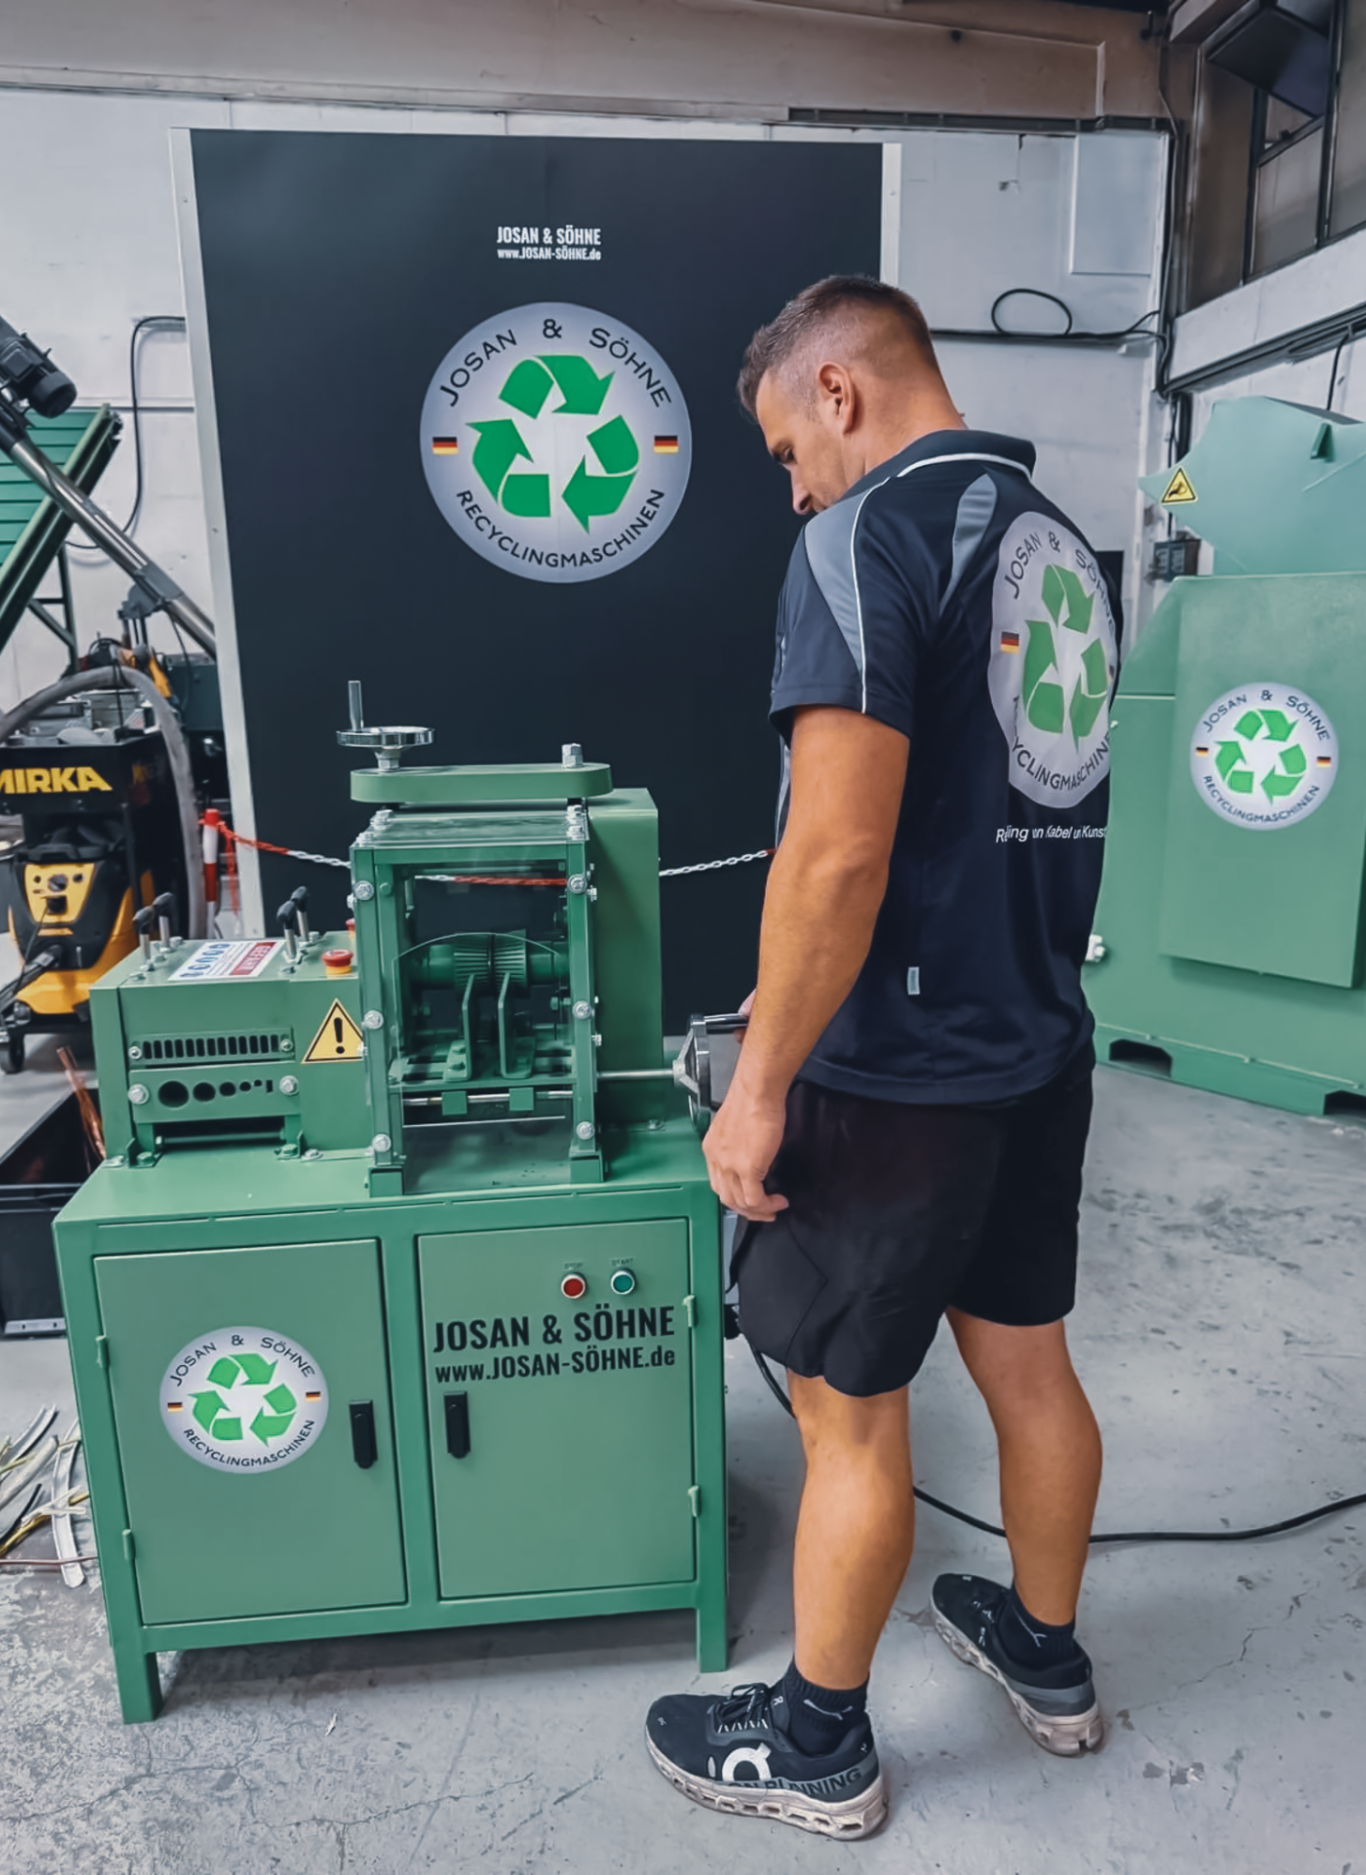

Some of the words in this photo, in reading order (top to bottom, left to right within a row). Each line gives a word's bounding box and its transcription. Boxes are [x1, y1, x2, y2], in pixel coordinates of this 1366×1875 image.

[497, 226, 539, 243] JOSAN
[543, 227, 553, 244] &
[556, 224, 602, 245] SÖHNE
[497, 245, 602, 260] www.JOSAN-SÖHNE.de
[440, 329, 518, 407] JOSAN
[542, 318, 562, 339] &
[589, 327, 672, 408] SÖHNE
[456, 489, 665, 568] RECYCLINGMASCHINEN
[1004, 532, 1043, 600] JOSAN
[1048, 530, 1061, 553] &
[1203, 694, 1247, 733] JOSAN
[1261, 690, 1273, 701] &
[1286, 695, 1331, 741] SÖHNE
[1203, 775, 1320, 823] RECYCLINGMASCHINEN
[433, 1316, 530, 1353] JOSAN
[542, 1314, 562, 1345] &
[574, 1303, 675, 1342] SÖHNE
[170, 1342, 217, 1387] JOSAN
[231, 1335, 244, 1346] &
[260, 1337, 315, 1378] SÖHNE
[435, 1345, 676, 1383] www.JOSAN-SÖHNE.de
[183, 1420, 315, 1467] RECYCLINGMASCHINEN
